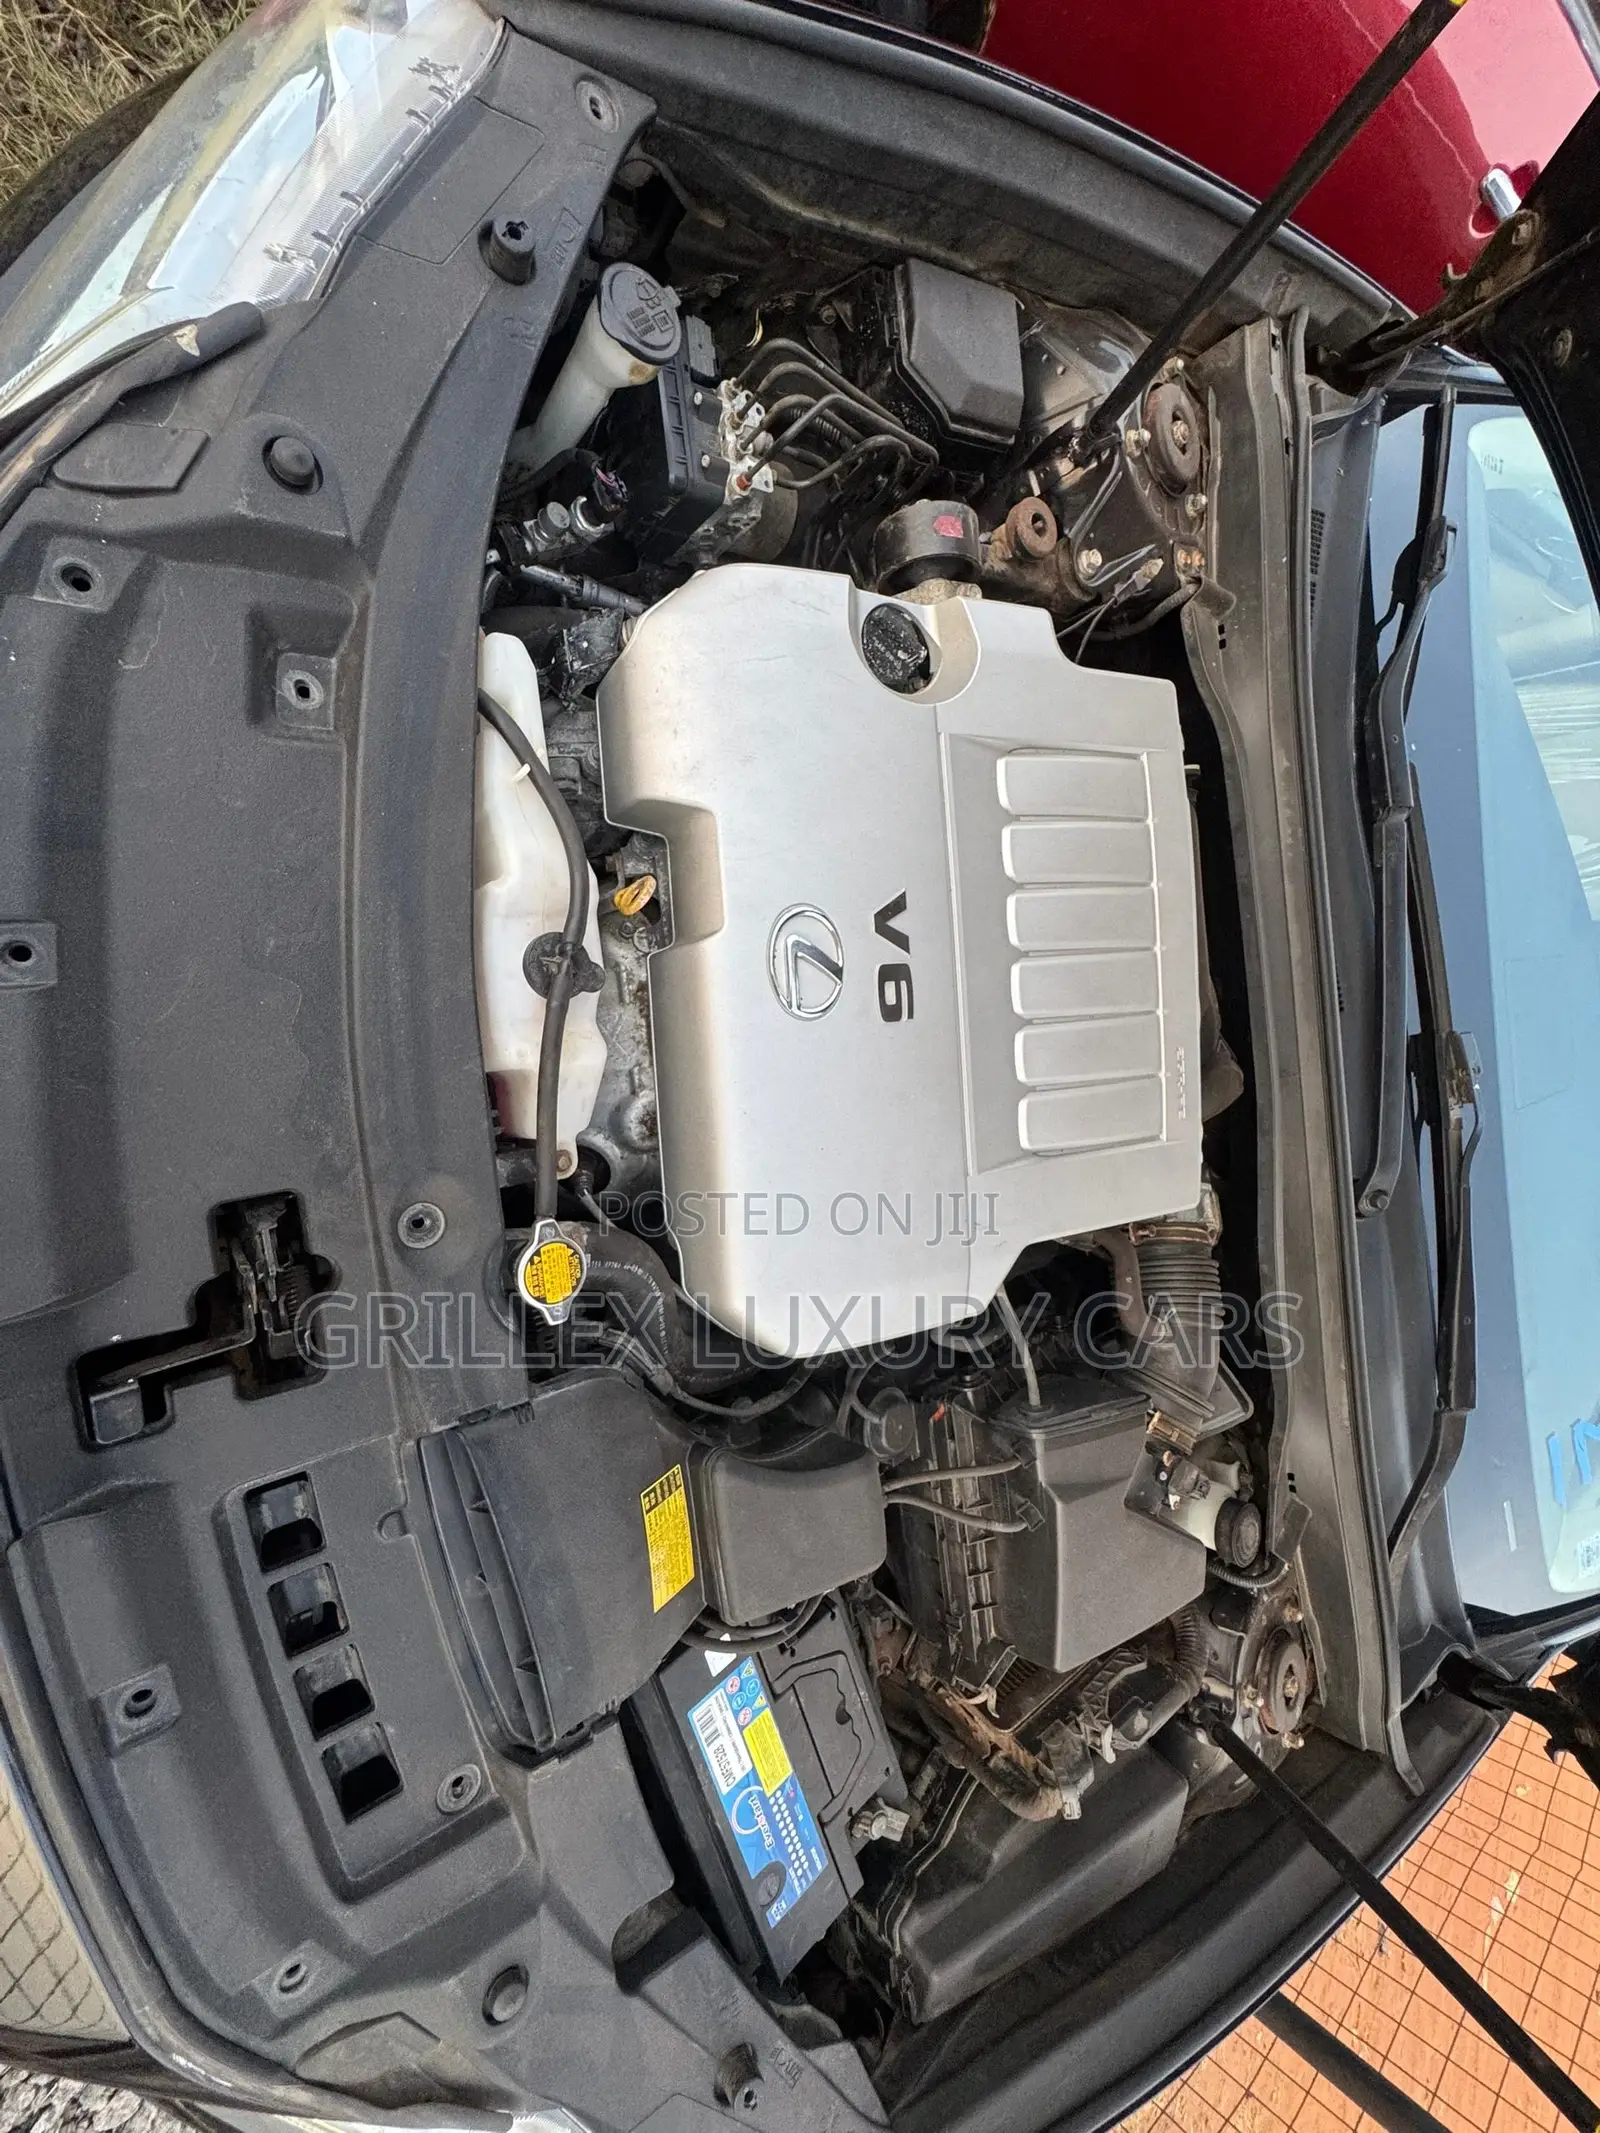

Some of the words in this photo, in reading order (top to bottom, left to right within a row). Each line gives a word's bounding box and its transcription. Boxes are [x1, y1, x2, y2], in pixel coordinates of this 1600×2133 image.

[872, 888, 914, 1023] V6
[713, 1743, 737, 1788] CMF57528
[748, 1795, 775, 1848] Everstart
